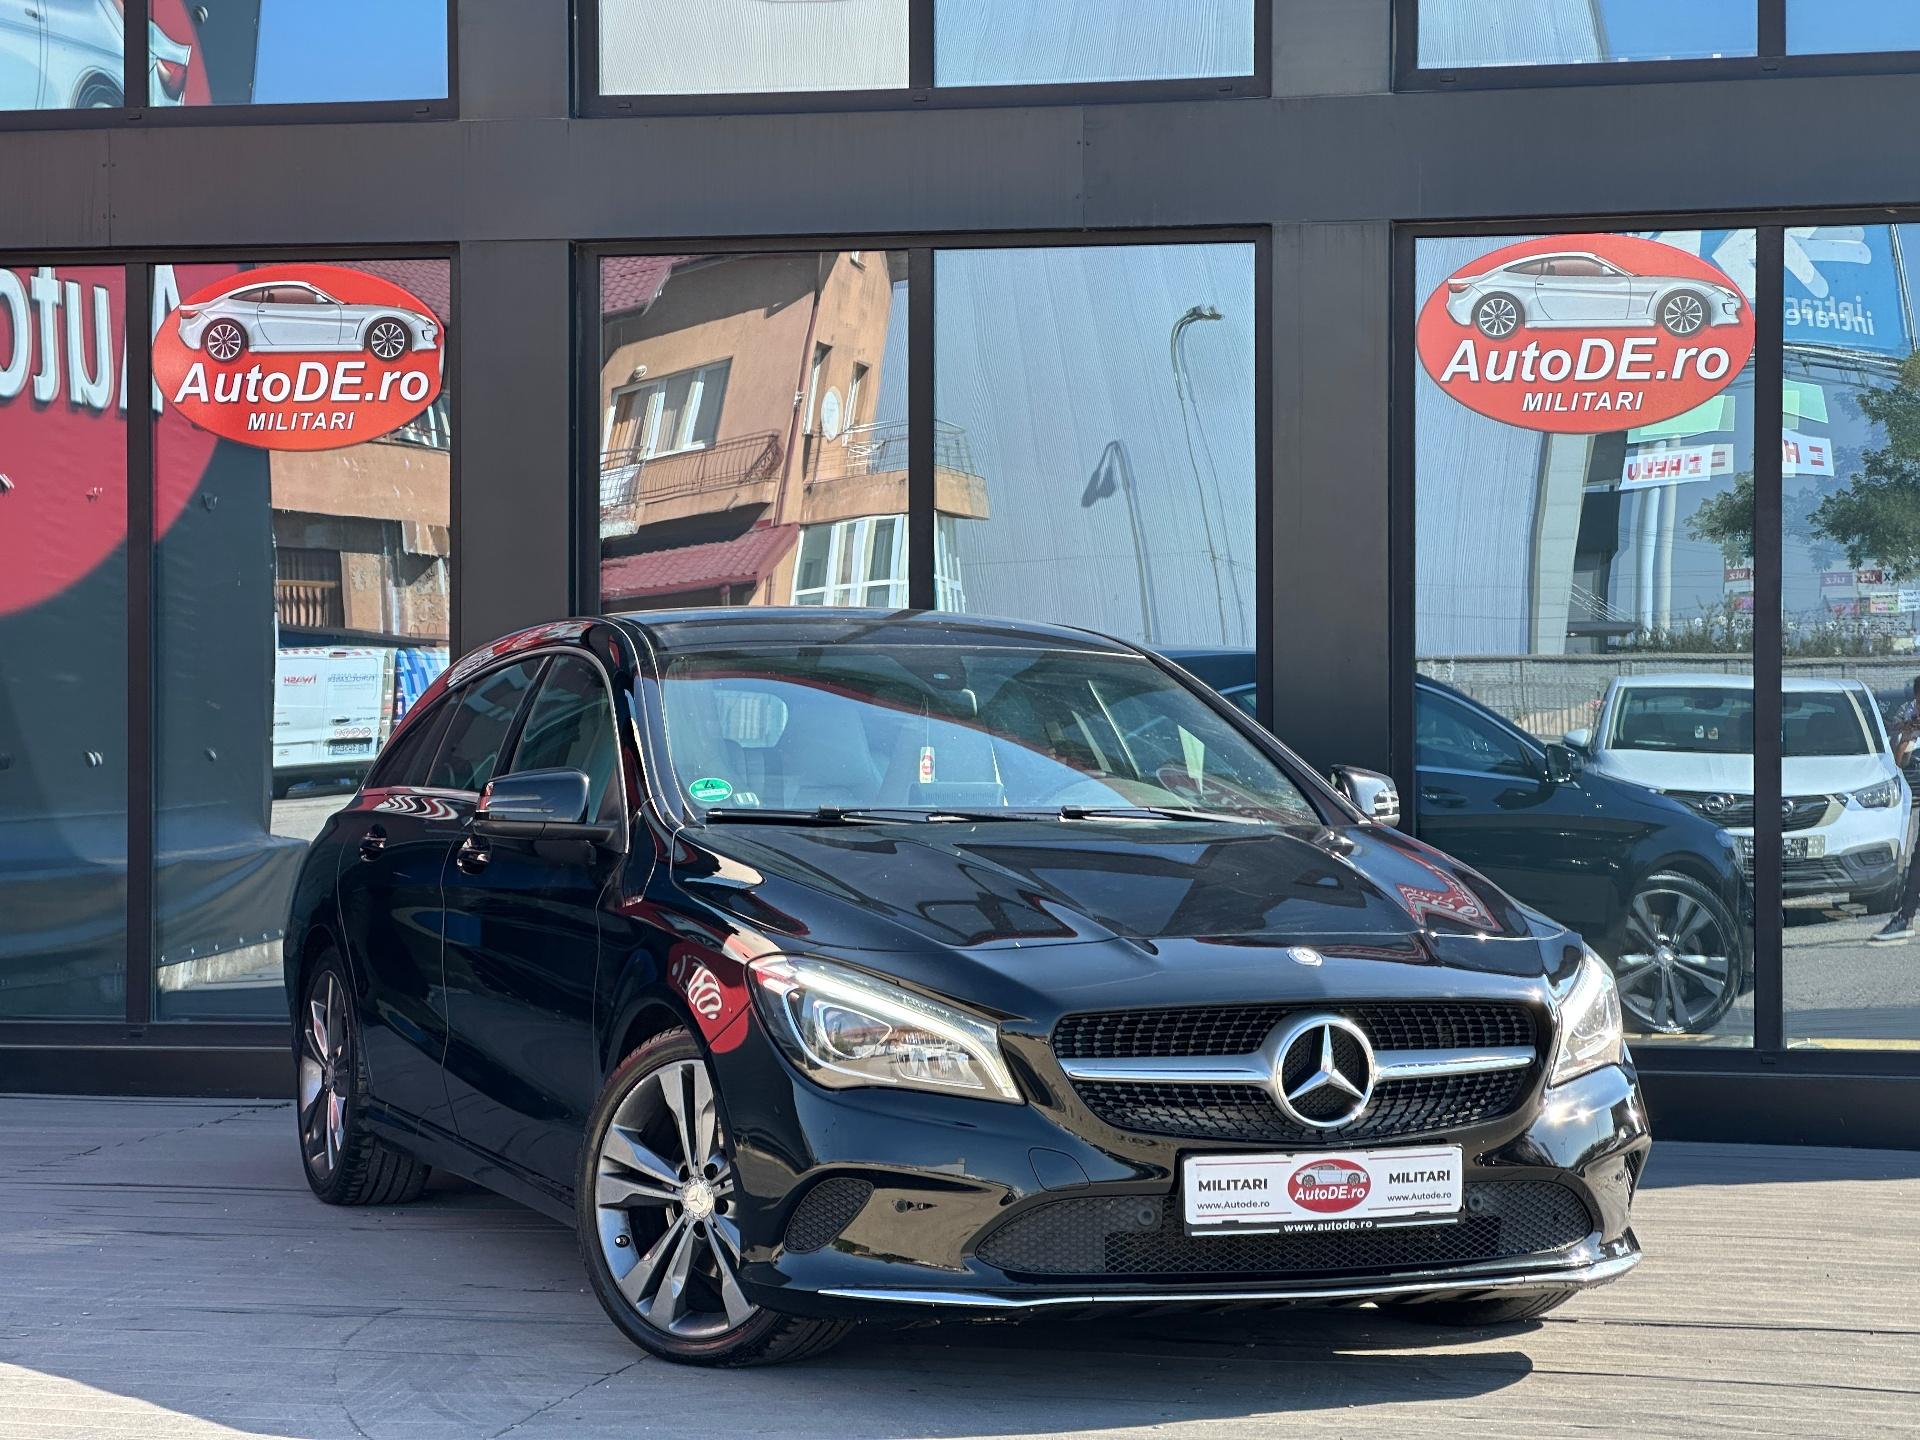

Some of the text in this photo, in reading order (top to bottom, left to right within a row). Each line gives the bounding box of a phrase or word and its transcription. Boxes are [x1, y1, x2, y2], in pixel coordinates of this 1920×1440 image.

[1440, 337, 1731, 382] AutoDE.ro
[174, 361, 430, 403] AutoDE.ro
[1522, 391, 1644, 412] MILITARI
[248, 411, 355, 431] MILITARI
[1198, 1178, 1268, 1192] MILITARI
[1388, 1169, 1451, 1185] MILITARI
[1294, 1185, 1366, 1201] AutoDE.ro
[1387, 1191, 1452, 1202] www.Autode.ro
[1197, 1199, 1270, 1210] www.Autode.ro
[1284, 1219, 1373, 1232] www.autode.ro
